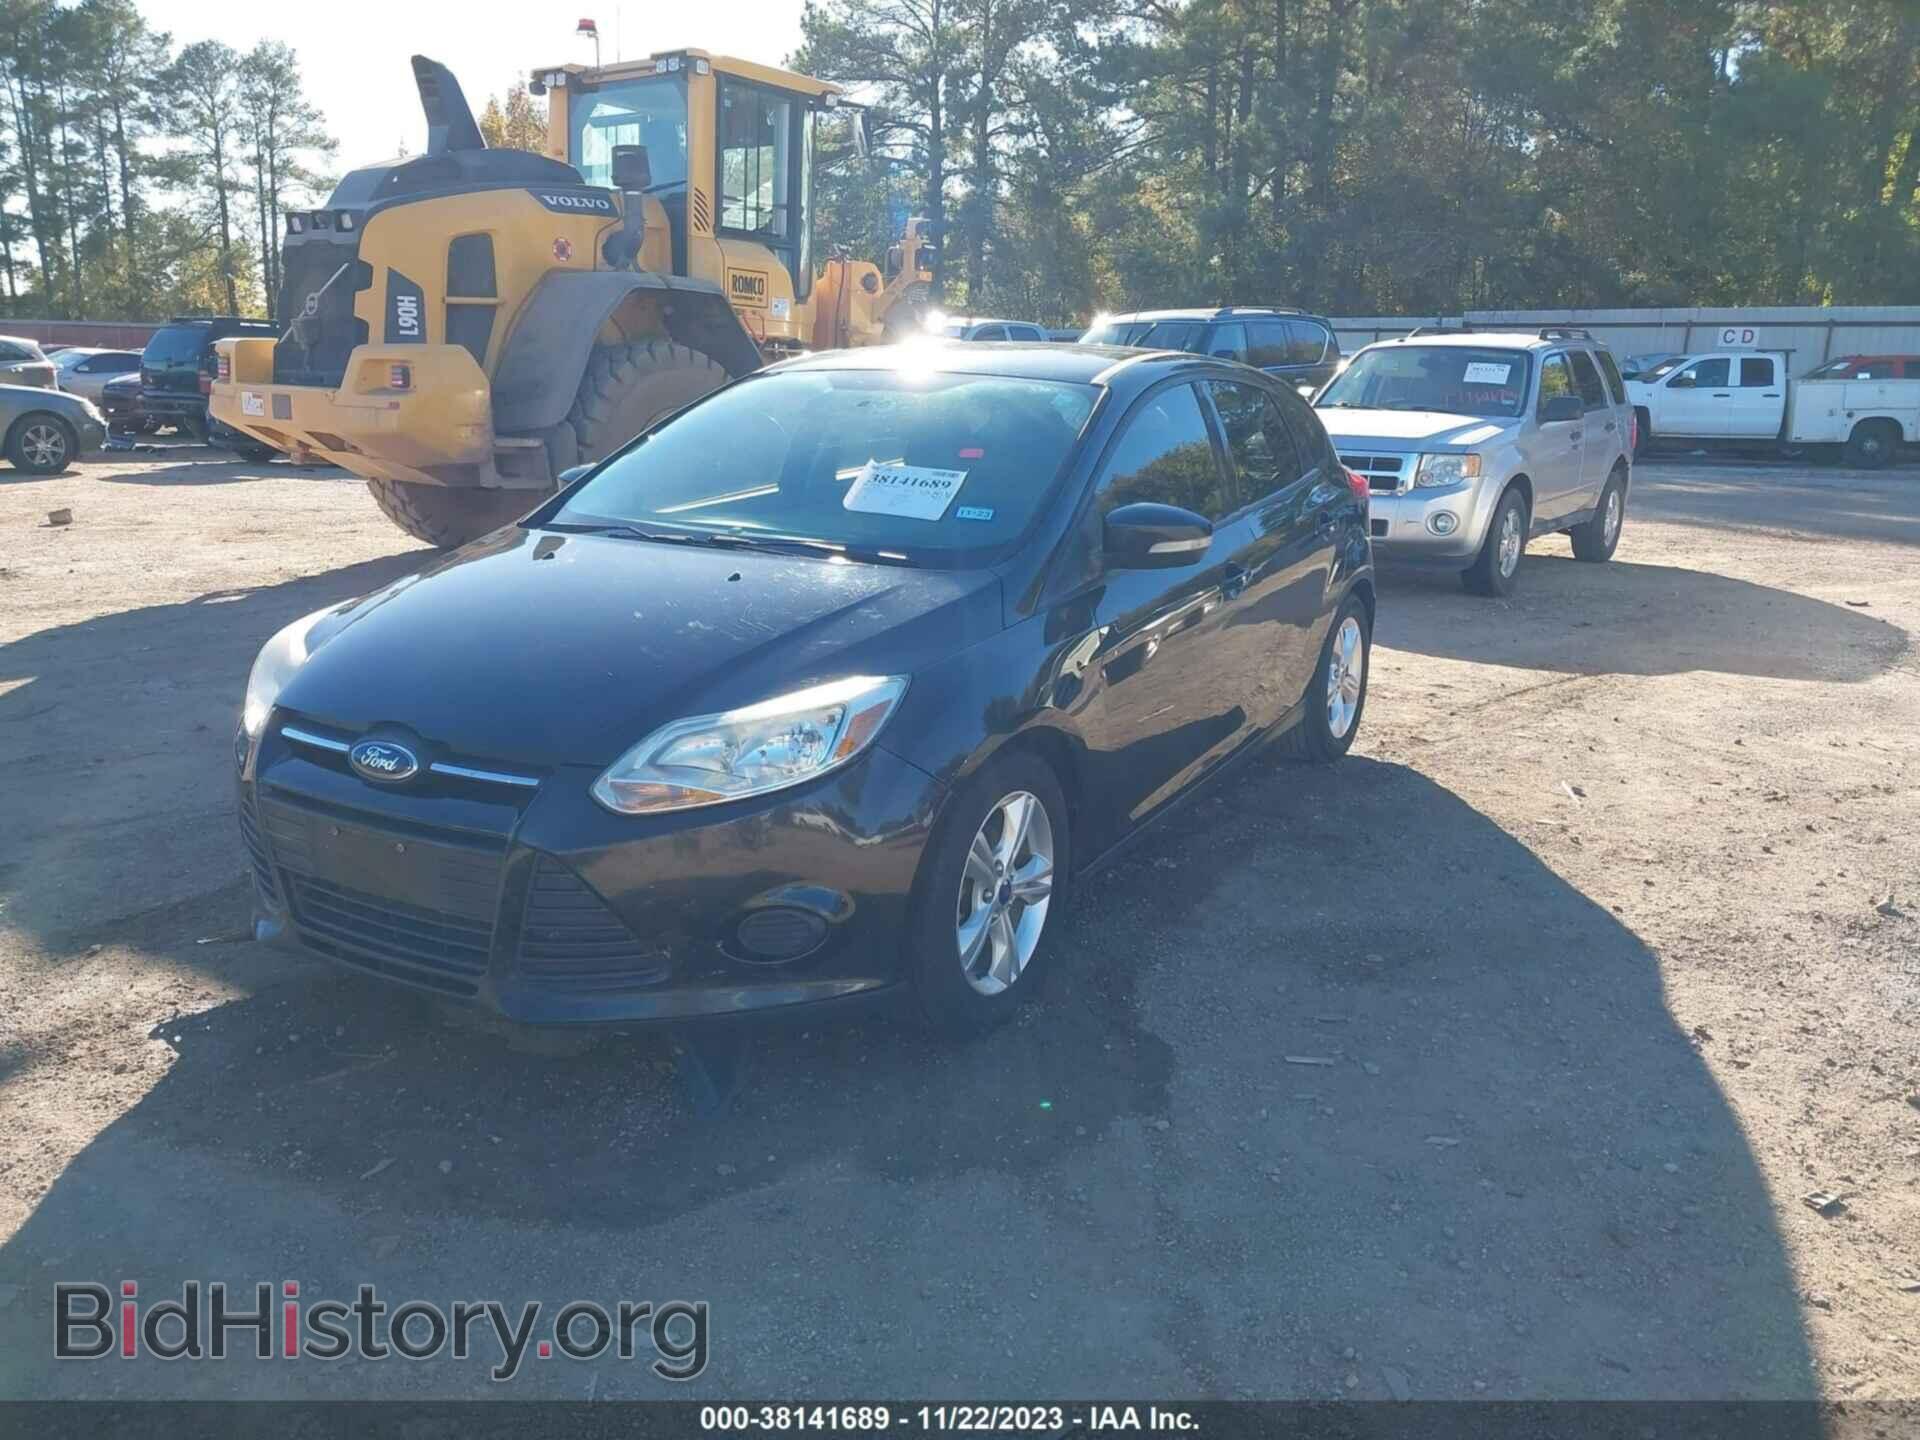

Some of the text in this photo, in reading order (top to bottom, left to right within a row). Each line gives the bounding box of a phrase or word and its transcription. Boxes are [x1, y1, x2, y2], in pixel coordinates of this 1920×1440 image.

[541, 194, 610, 210] VOLVO
[731, 273, 765, 296] ROMCO
[396, 295, 419, 336] L90H
[871, 472, 952, 490] 38141689
[360, 745, 400, 772] Ford
